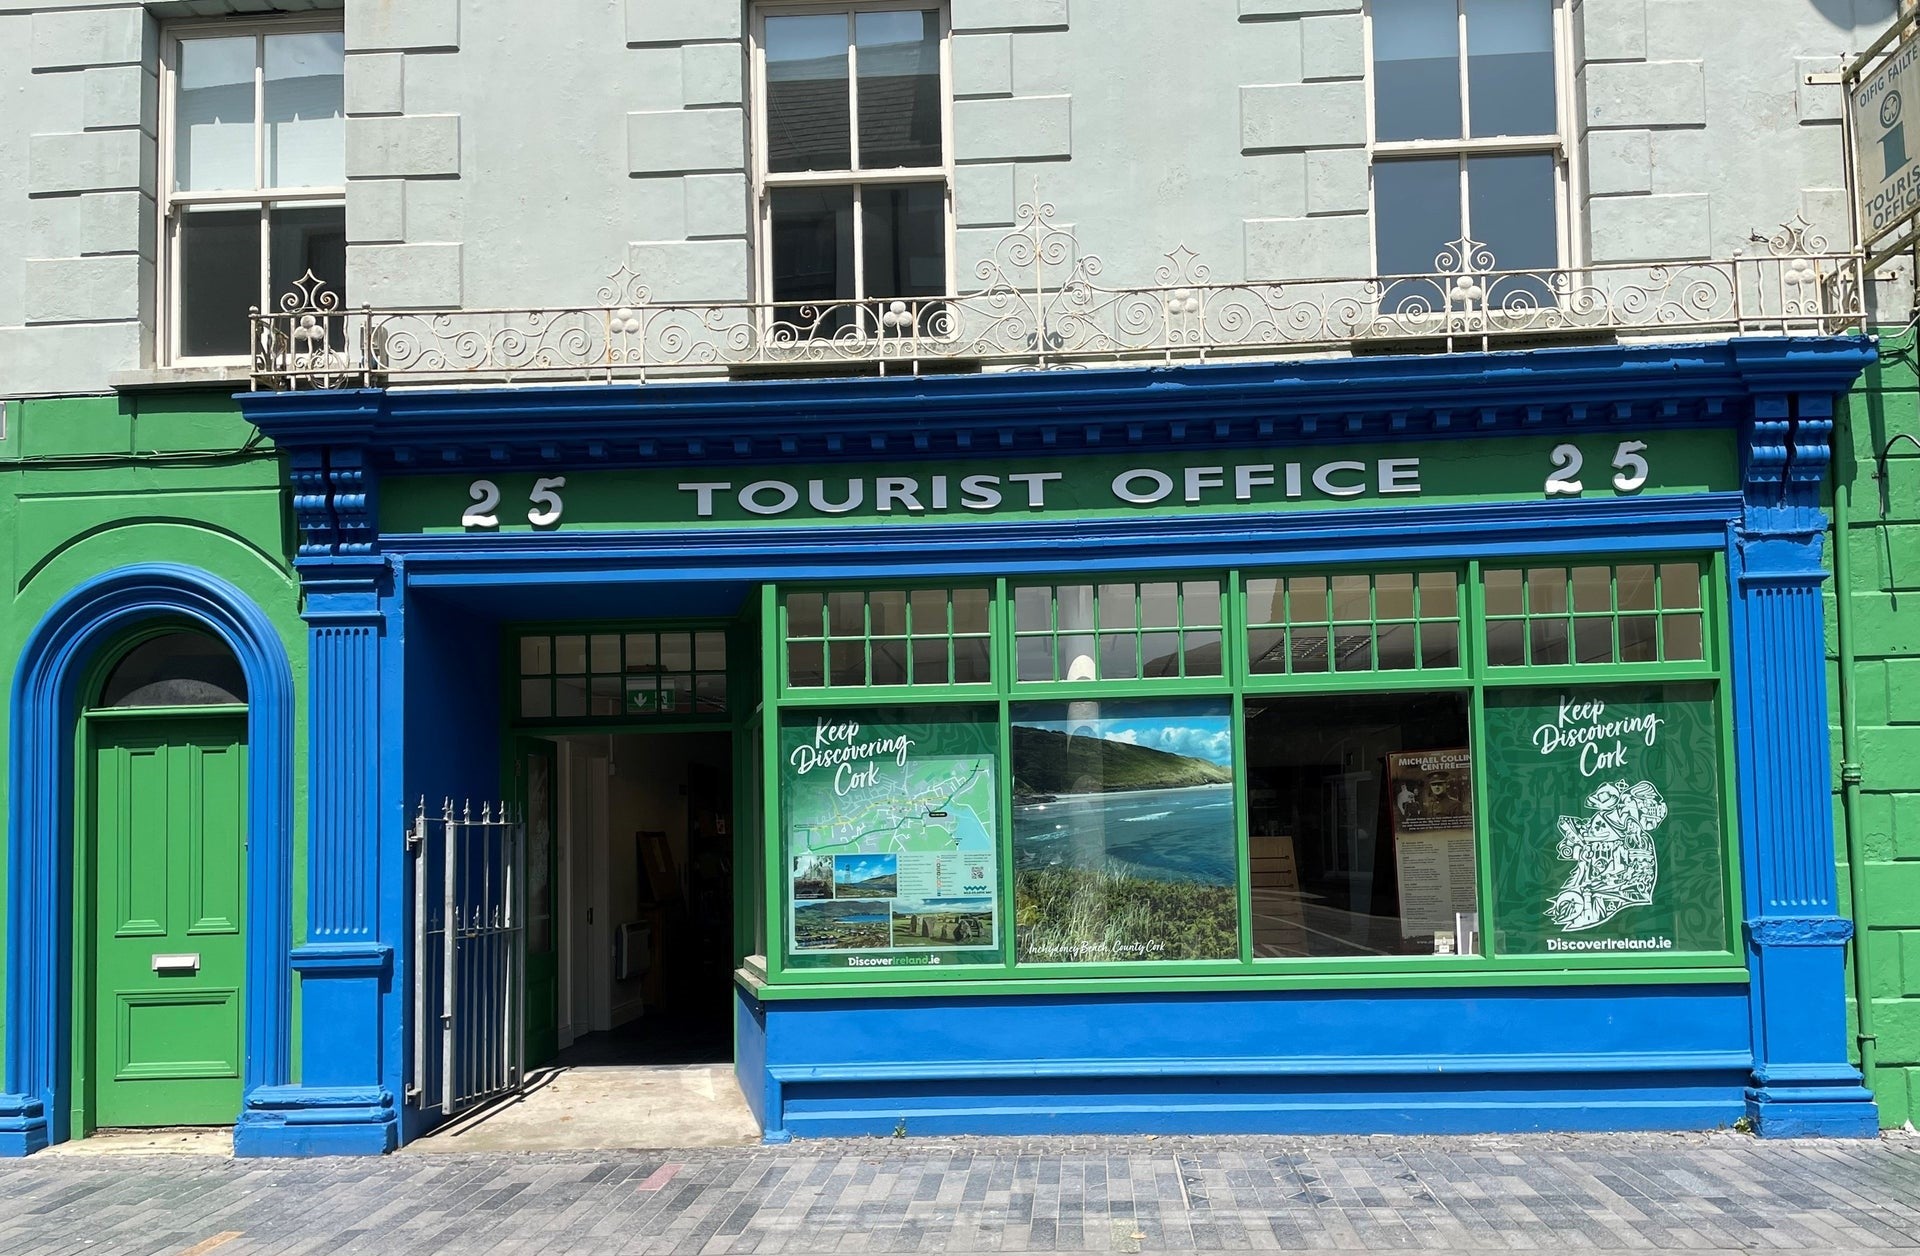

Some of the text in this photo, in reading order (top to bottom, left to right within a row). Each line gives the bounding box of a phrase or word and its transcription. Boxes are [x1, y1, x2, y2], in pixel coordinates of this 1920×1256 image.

[1859, 76, 1885, 108] OIFIG
[678, 472, 1063, 516] TOURIST
[1111, 457, 1422, 504] OFFICE
[1558, 694, 1605, 729] Keep
[815, 716, 860, 749] Keep
[1532, 712, 1665, 755] Discovering
[790, 734, 916, 775] Discovering
[1398, 756, 1439, 767] MICHAEL
[1420, 762, 1456, 771] CENTRE
[1579, 740, 1629, 777] Cork
[834, 760, 880, 796] Cork
[1111, 939, 1146, 956] County
[1145, 938, 1166, 953] Cork
[1546, 935, 1673, 951] DiscoverIreland.ie
[847, 954, 941, 967] DiscoverIreland.ie
